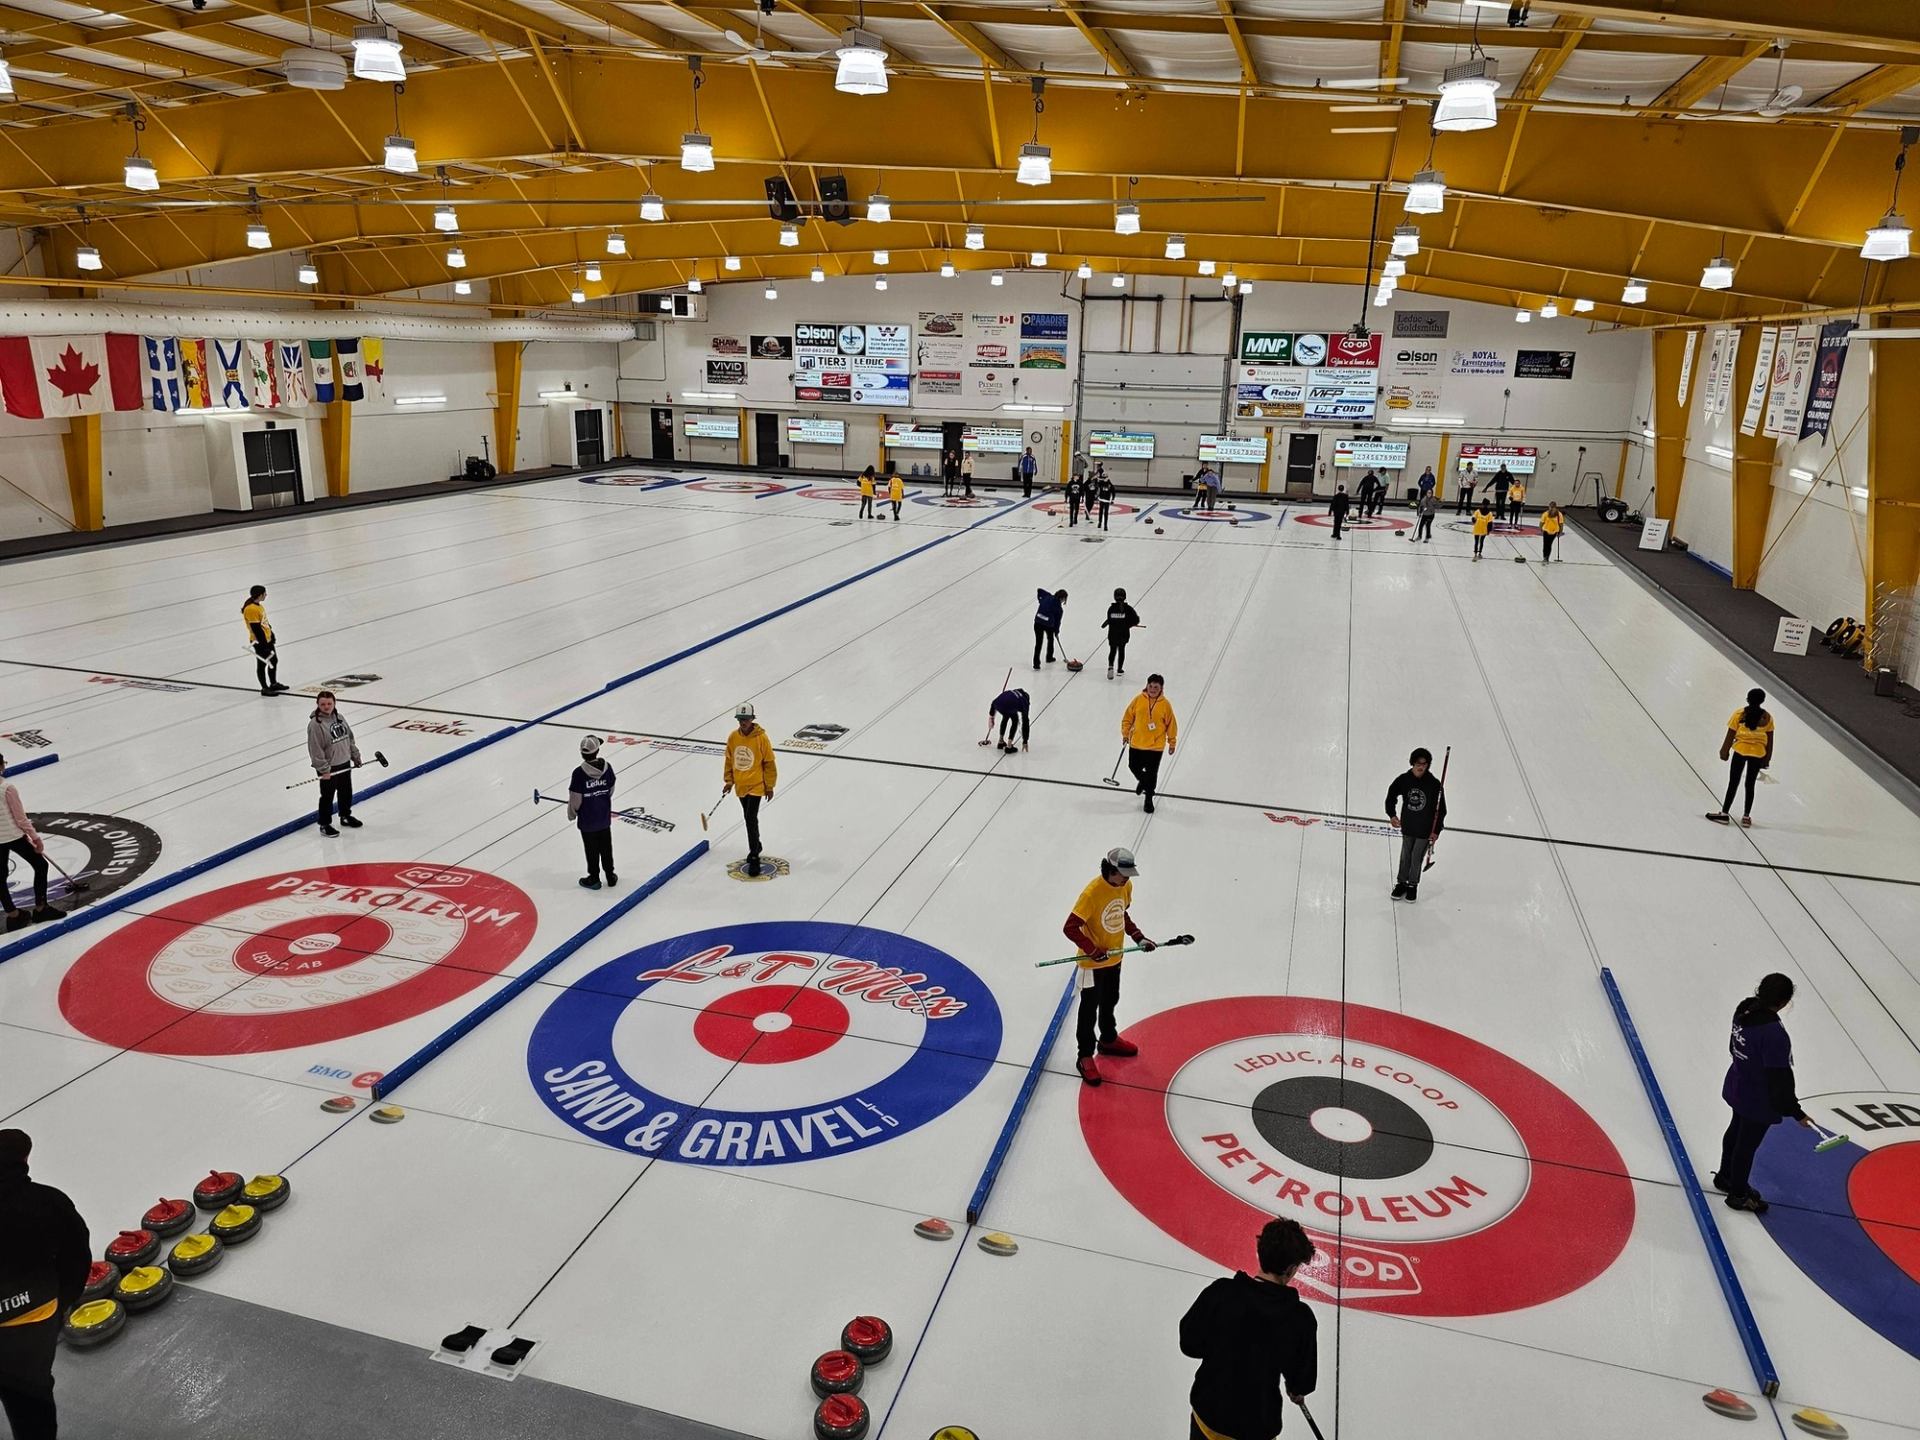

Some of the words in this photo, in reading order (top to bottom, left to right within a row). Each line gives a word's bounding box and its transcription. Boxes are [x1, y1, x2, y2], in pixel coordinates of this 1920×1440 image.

[797, 325, 836, 339] Olson
[1397, 323, 1445, 333] Goldsmiths
[712, 337, 739, 348] SHAW
[1245, 338, 1288, 353] MNP
[818, 357, 847, 367] TIER3
[855, 358, 884, 366] LEDUC
[1397, 350, 1438, 362] Olson
[1472, 351, 1498, 359] ROYAL
[712, 361, 742, 371] VIVID
[1821, 370, 1838, 384] Target
[1271, 388, 1301, 397] Rebel
[388, 719, 475, 737] Leduc
[585, 779, 607, 789] Leduc
[1324, 819, 1376, 829] Windsor
[47, 818, 140, 876] PRE-OWNED
[267, 877, 522, 928] PETROLEUM
[298, 959, 322, 969] AB
[818, 959, 972, 1020] Mix
[306, 1064, 353, 1080] BMO
[1233, 1050, 1323, 1073] LEDUC,
[1329, 1052, 1366, 1070] AB
[1374, 1064, 1460, 1112] CO-OP
[544, 1060, 645, 1132] SAND
[625, 1111, 679, 1151] &
[679, 1105, 872, 1161] GRAVEL
[1201, 1132, 1488, 1224] PETROLEUM
[0, 1290, 30, 1314] TON
